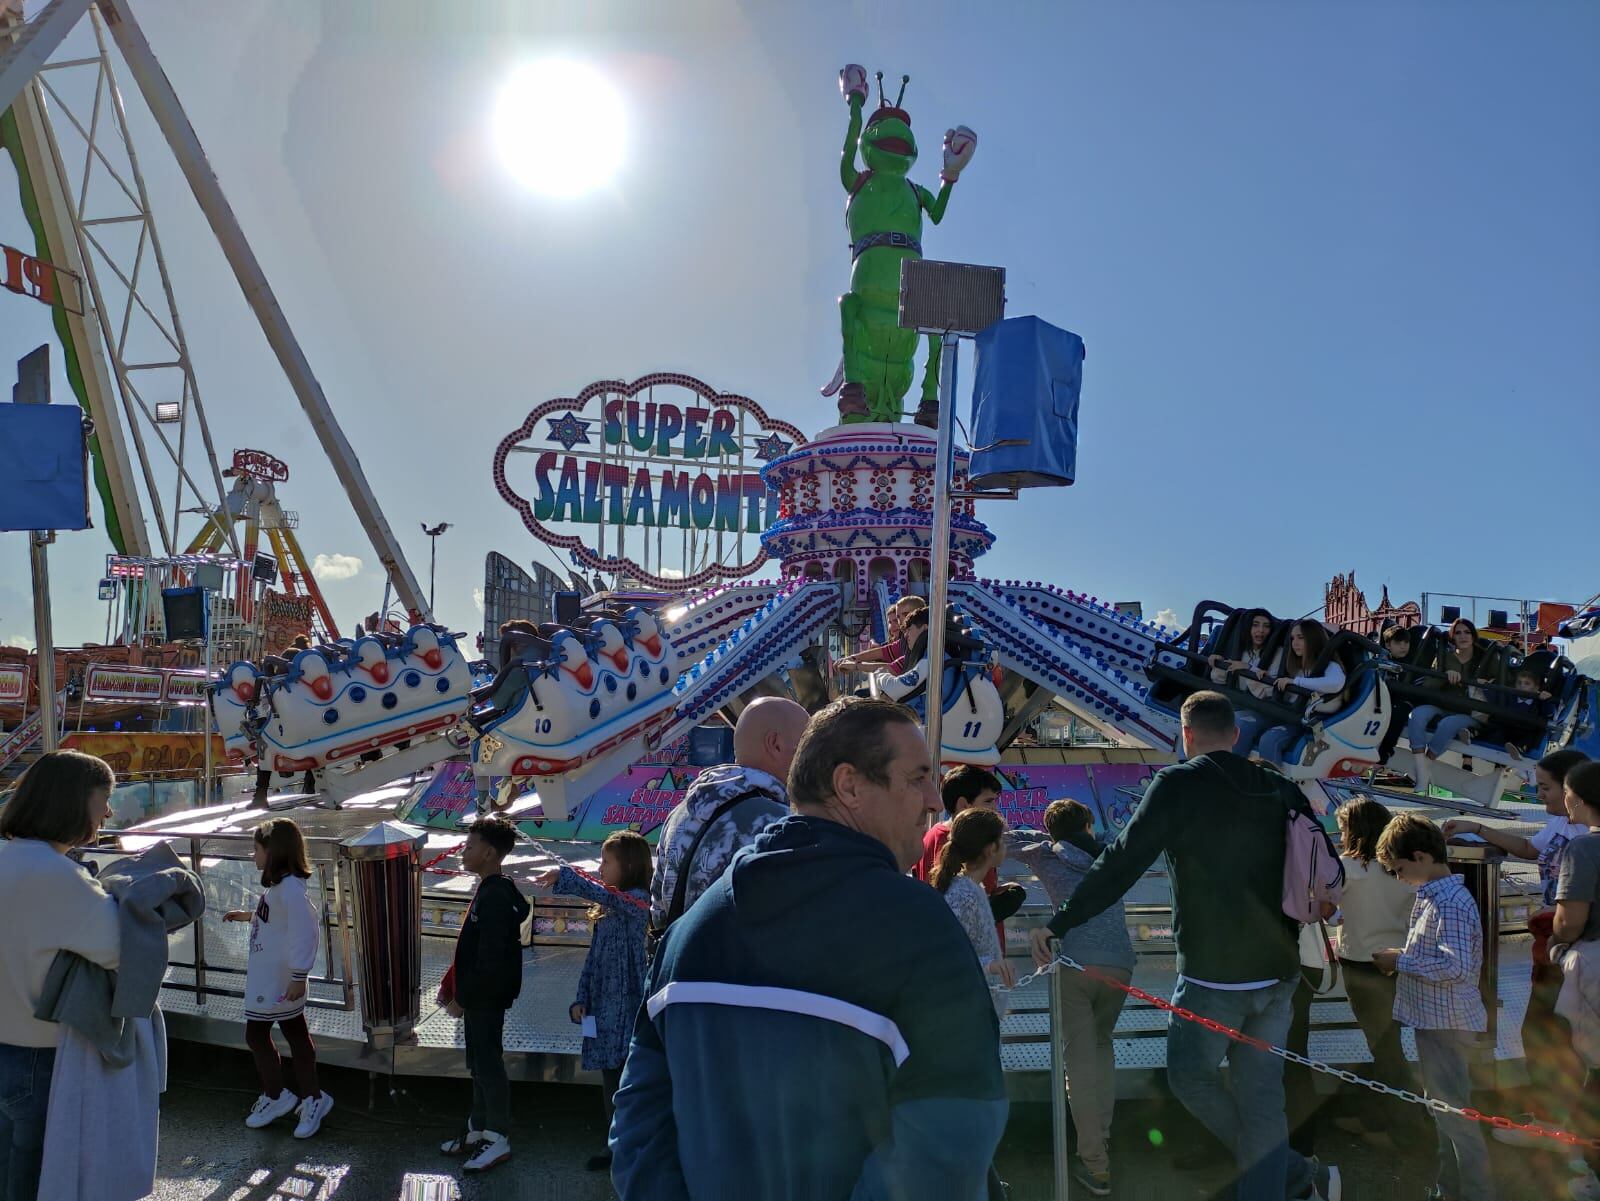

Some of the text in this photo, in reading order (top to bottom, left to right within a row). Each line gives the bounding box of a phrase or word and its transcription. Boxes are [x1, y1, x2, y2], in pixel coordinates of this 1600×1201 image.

[604, 399, 740, 458] SUPER
[278, 724, 284, 737] 9
[535, 717, 552, 734] 10
[963, 721, 982, 738] 11
[1363, 720, 1381, 736] 12
[631, 788, 688, 807] SUPE
[994, 788, 1049, 809] PER
[602, 805, 671, 825] SALTAM
